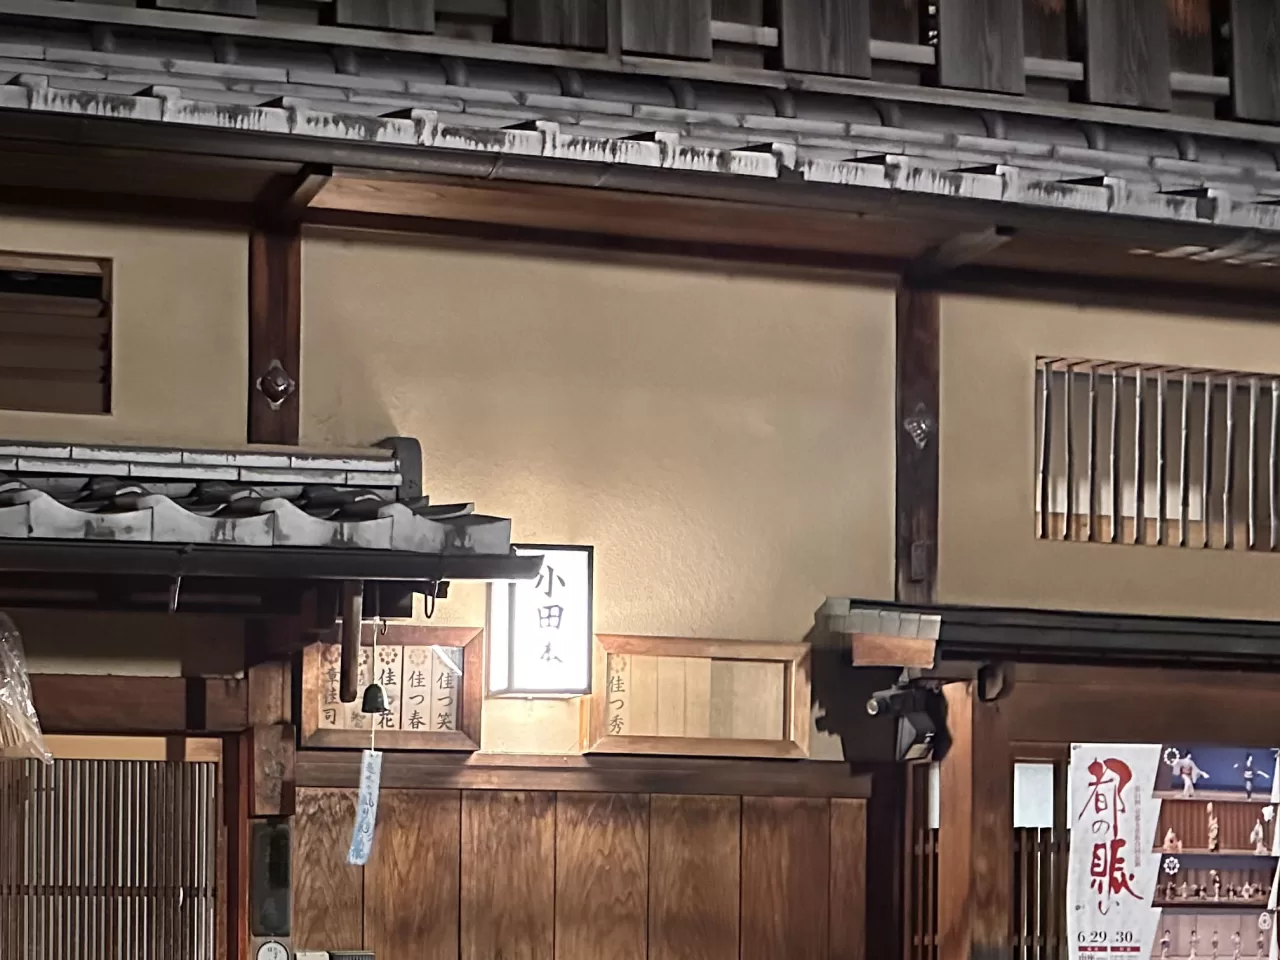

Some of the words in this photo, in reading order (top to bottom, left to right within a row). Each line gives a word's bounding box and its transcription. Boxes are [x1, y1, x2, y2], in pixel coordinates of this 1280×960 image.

[535, 565, 566, 663] 小田本
[408, 670, 426, 730] 佳つ春
[436, 671, 454, 731] 佳つ笑
[609, 675, 626, 735] 佳つ秀
